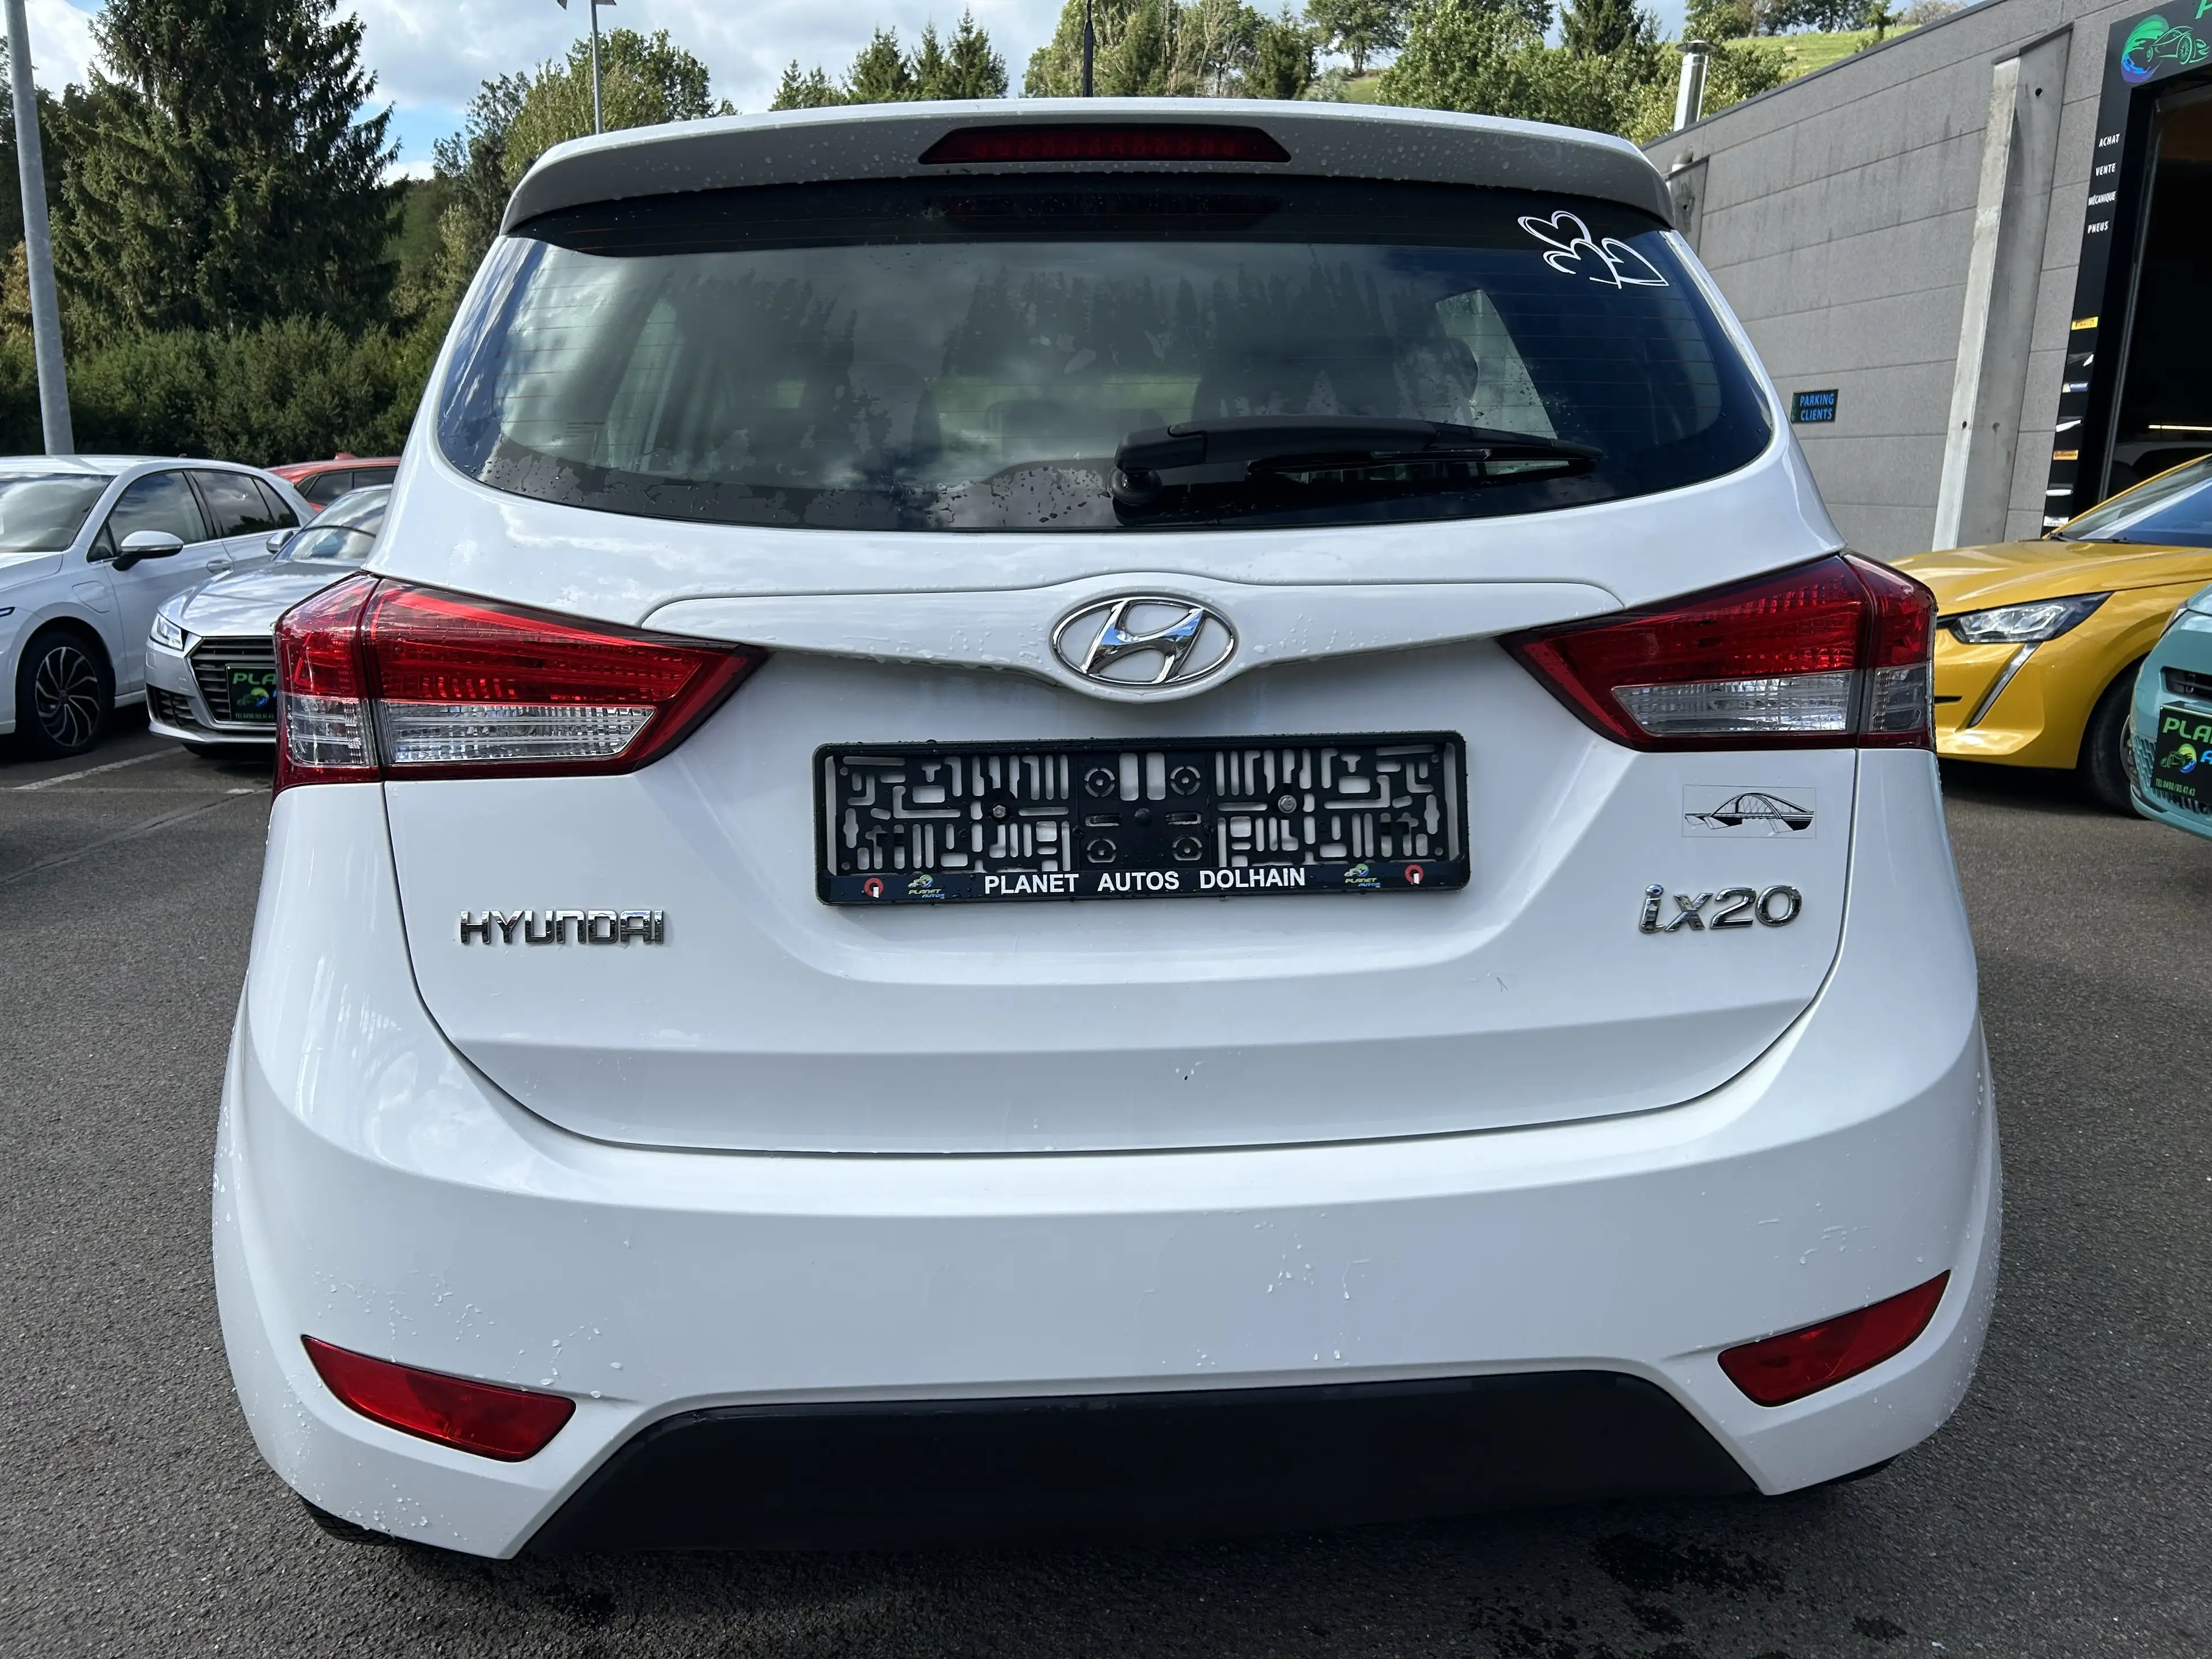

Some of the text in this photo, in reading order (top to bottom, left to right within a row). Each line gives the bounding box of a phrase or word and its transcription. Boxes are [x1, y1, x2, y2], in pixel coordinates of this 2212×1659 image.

[2099, 133, 2120, 147] ACHAT
[2095, 162, 2116, 176] VENTE
[2087, 221, 2109, 234] PNEUS
[1800, 393, 1834, 406] PARKING
[1800, 408, 1832, 421] CLIENTS
[2162, 717, 2212, 744] PLA
[984, 868, 1305, 895] PLANET AUTOS DOLHAIN
[1639, 884, 1802, 934] ix20
[460, 910, 664, 944] HYUNDAI
